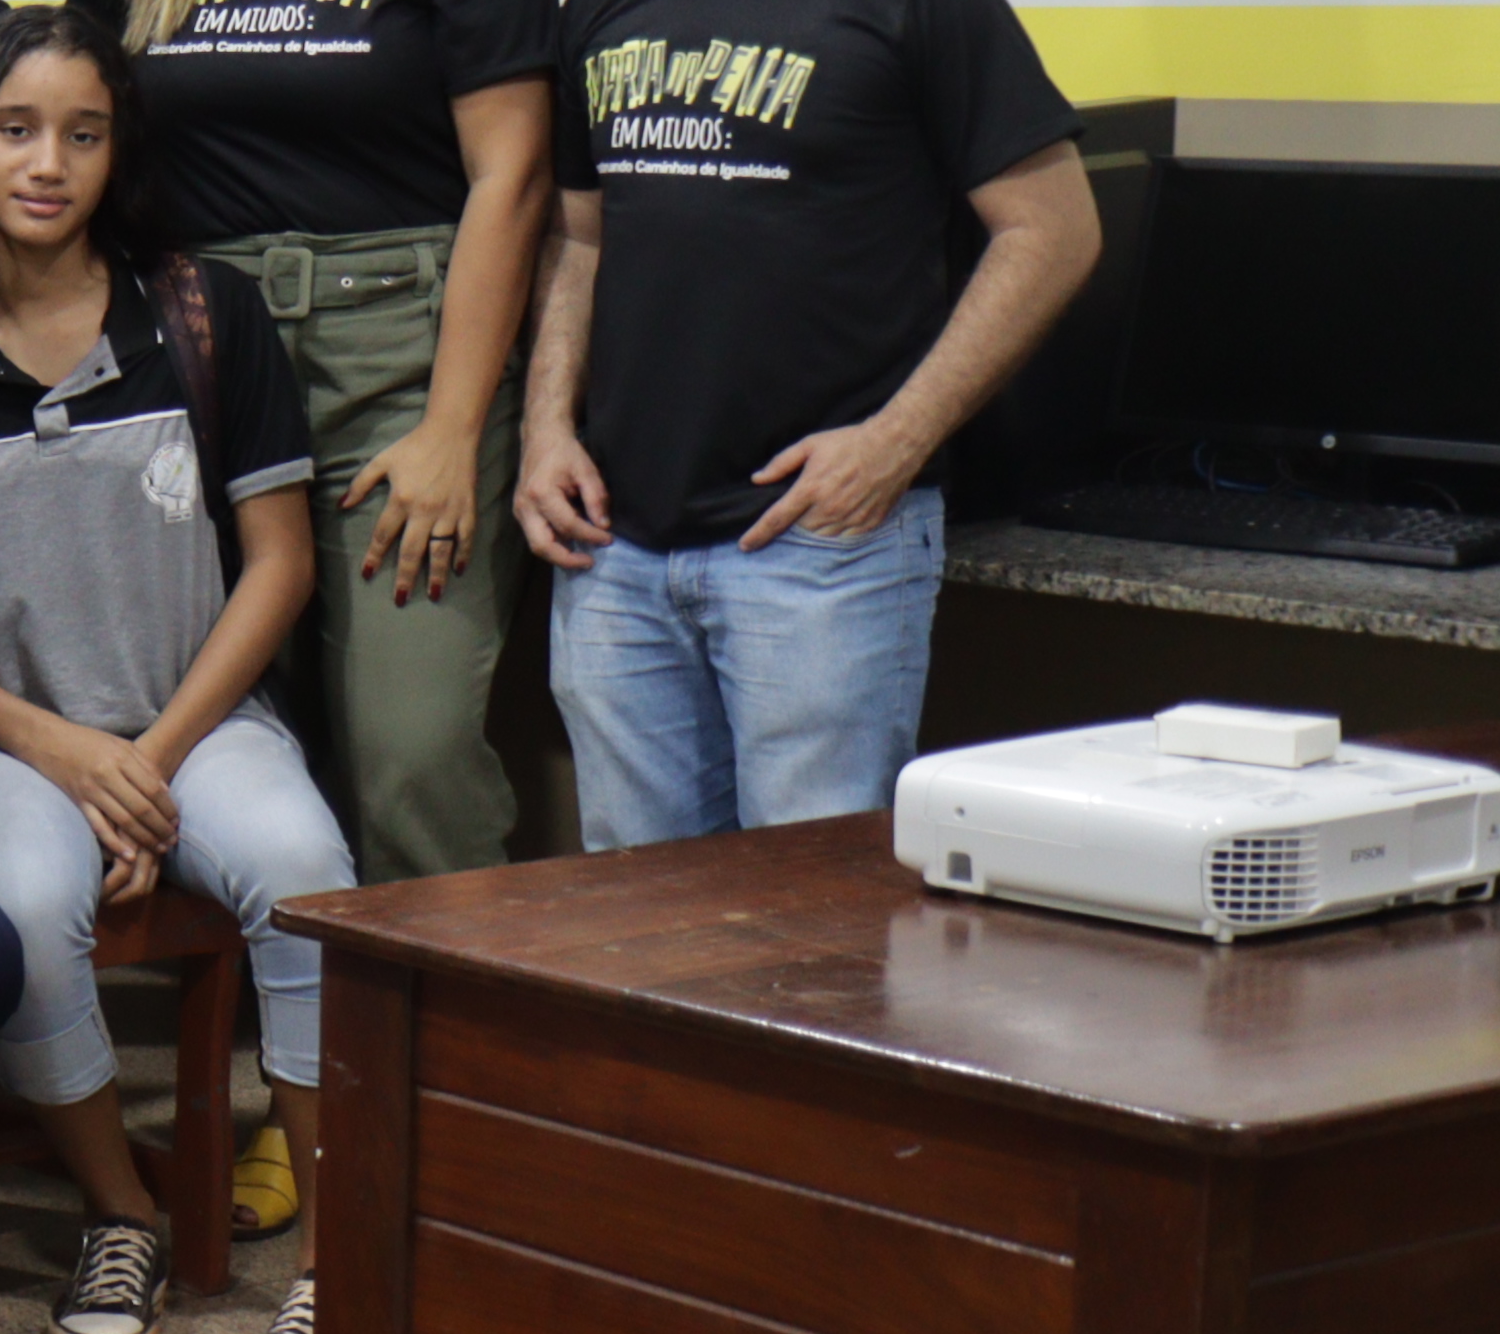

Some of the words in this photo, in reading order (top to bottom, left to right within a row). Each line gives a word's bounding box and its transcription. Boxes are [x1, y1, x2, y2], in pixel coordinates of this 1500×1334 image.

[194, 9, 227, 33] EM
[216, 40, 281, 53] Caminhos
[284, 40, 302, 53] de
[304, 40, 371, 55] Igualdade
[585, 39, 667, 129] MARIA
[699, 39, 815, 129] PENHA
[611, 117, 640, 150] EM
[635, 160, 697, 175] Caminhos
[699, 162, 717, 176] de
[719, 163, 790, 180] Igualdade
[1351, 845, 1386, 863] EPSON
